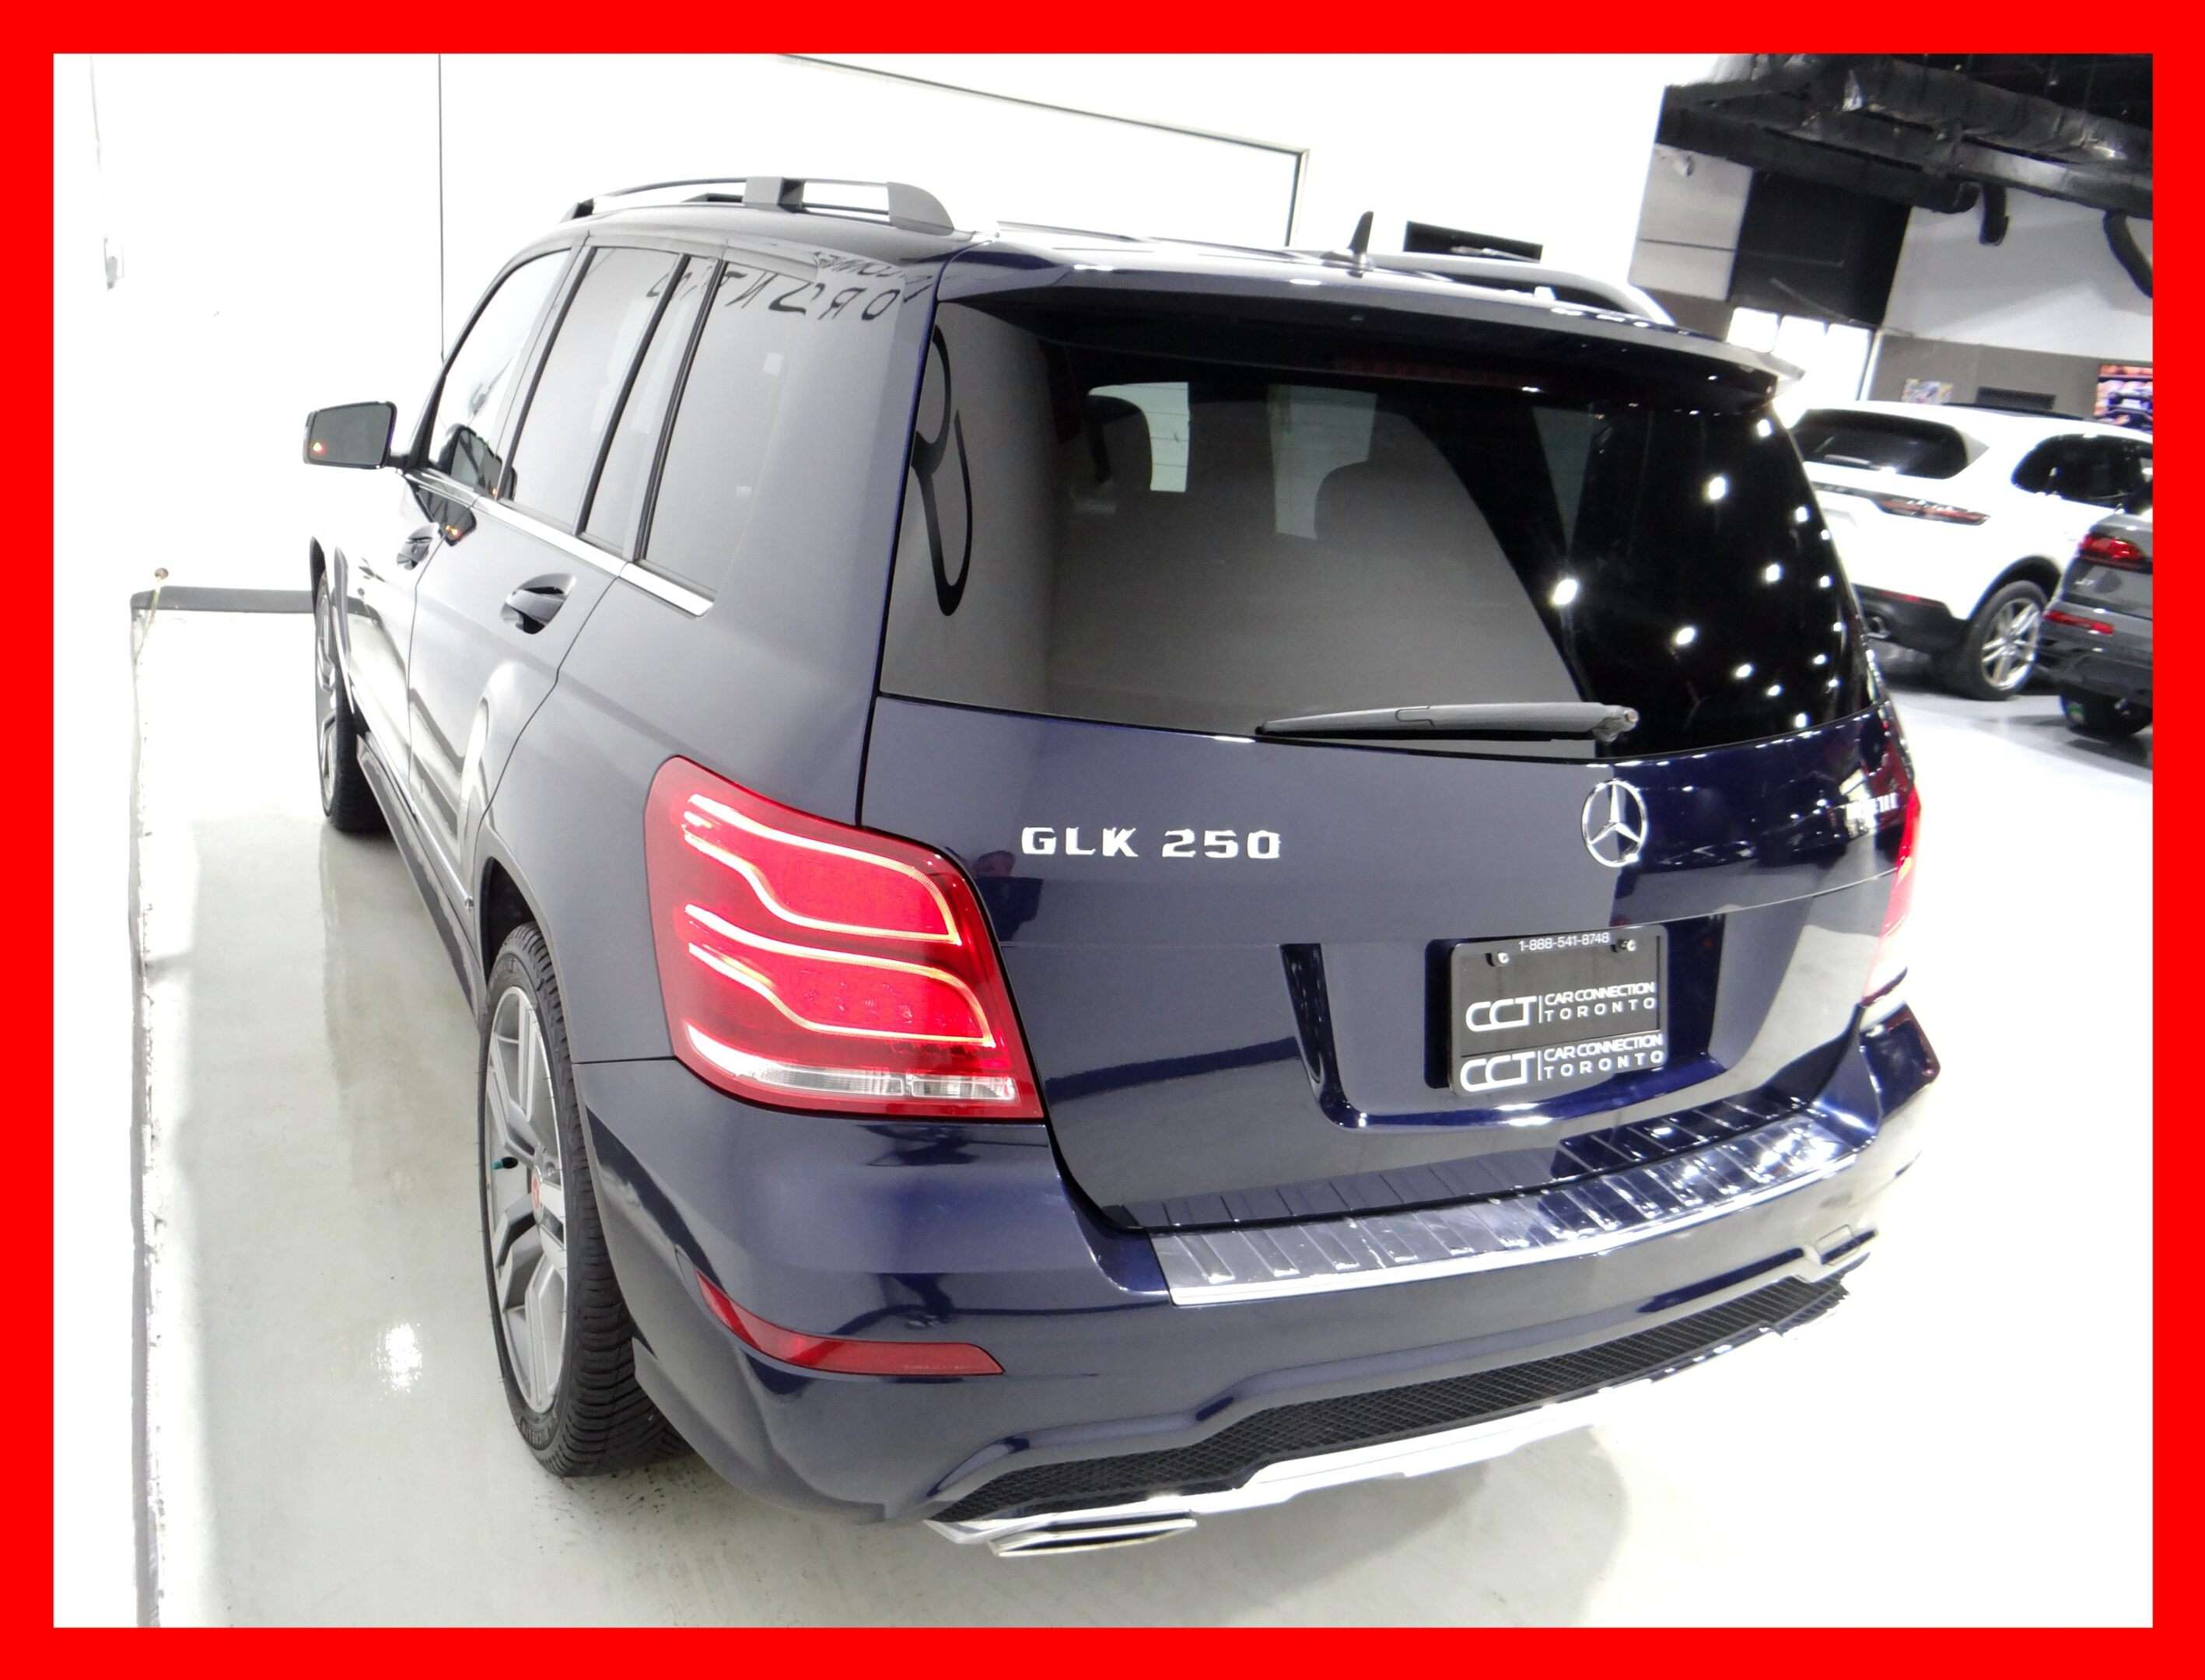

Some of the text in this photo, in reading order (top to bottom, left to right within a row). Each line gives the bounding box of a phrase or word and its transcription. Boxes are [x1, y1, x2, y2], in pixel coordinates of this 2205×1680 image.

[1021, 827, 1282, 859] GLK 250
[1518, 932, 1610, 951] 1-888-541-8748
[1465, 982, 1655, 1032] CCT CAR CONNECTION
[1545, 997, 1656, 1022] TORONTO
[1460, 1034, 1663, 1092] CCT CAR CONNECTION
[1544, 1050, 1664, 1080] TORONTO
